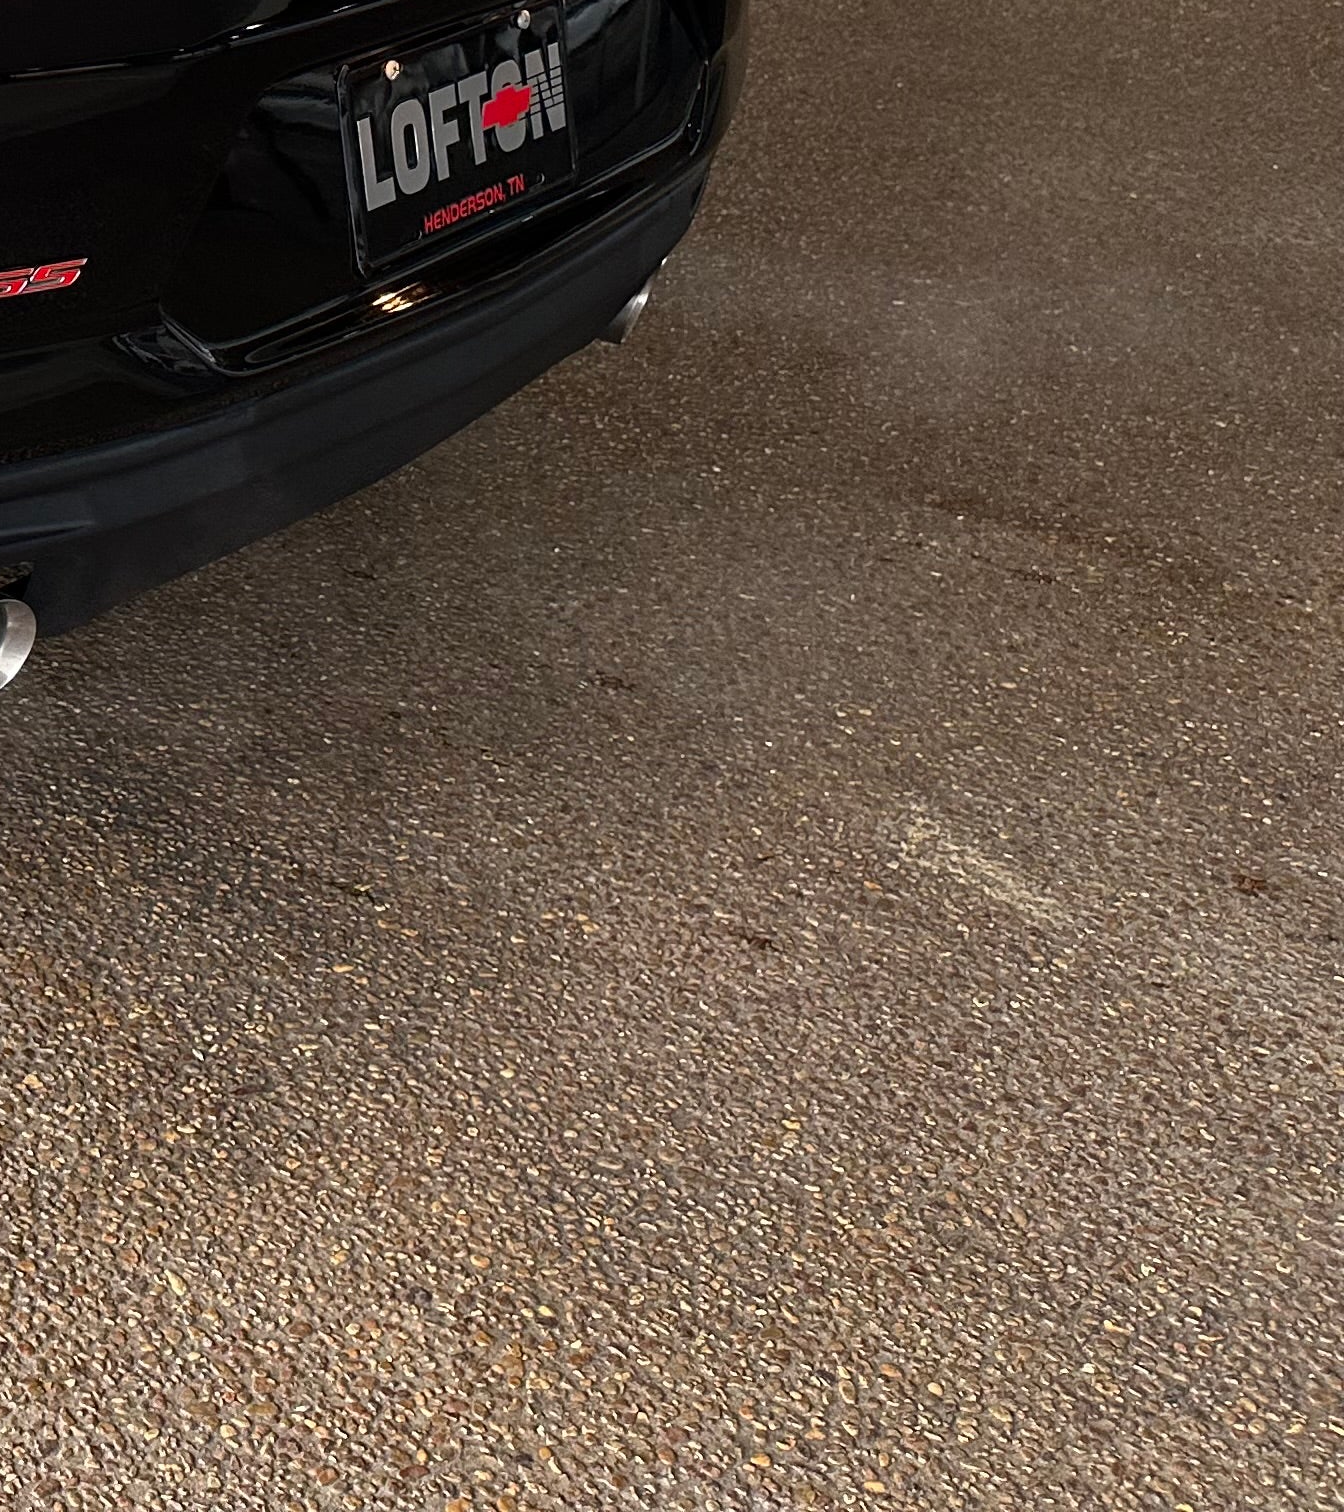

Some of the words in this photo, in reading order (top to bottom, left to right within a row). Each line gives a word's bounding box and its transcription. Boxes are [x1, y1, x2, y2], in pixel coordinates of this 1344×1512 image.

[357, 41, 566, 211] LOFTON
[424, 185, 506, 234] HENDERSON,
[507, 173, 525, 194] TN
